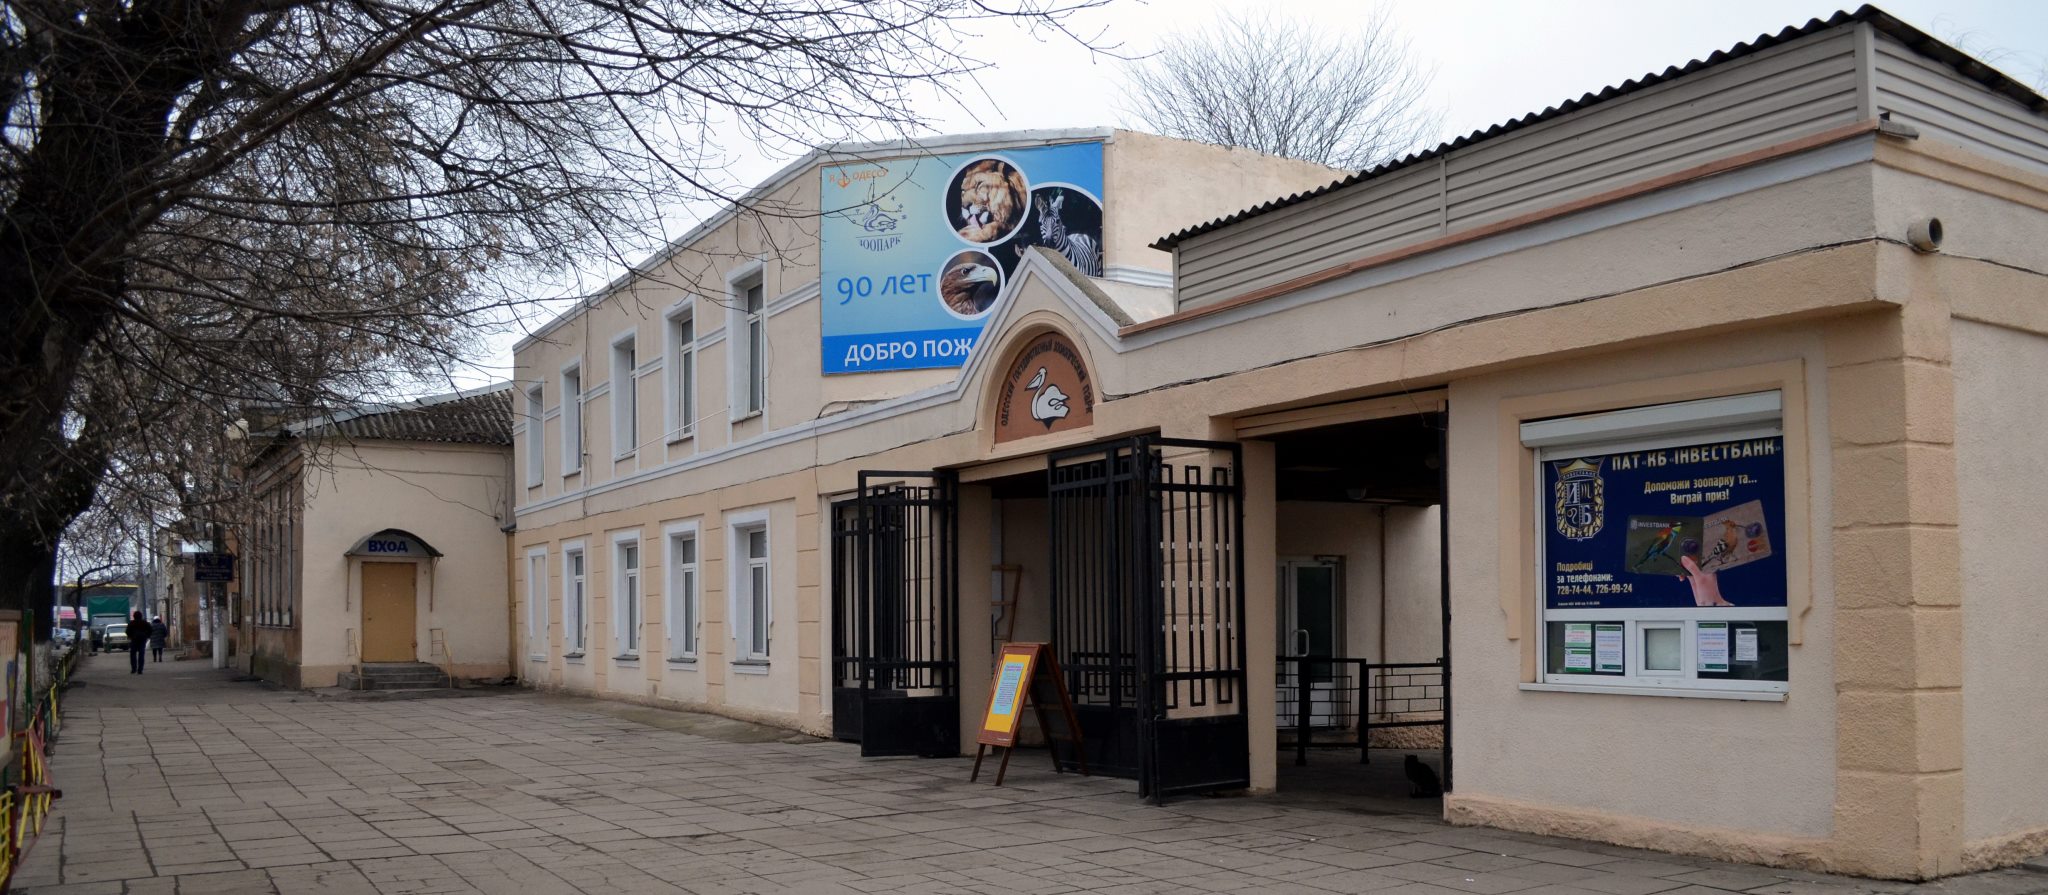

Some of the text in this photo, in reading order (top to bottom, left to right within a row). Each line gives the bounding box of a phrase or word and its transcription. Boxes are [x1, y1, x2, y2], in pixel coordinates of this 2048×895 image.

[837, 273, 932, 305] 90 лет
[844, 340, 917, 367] ДОБРО
[1612, 454, 1641, 471] ПАТ
[1644, 474, 1757, 495] Допоможи зоопарку та...
[1670, 489, 1730, 506] Виграй приз!
[368, 540, 408, 552] ВХОД
[1556, 560, 1593, 572] Подробиці
[1557, 573, 1614, 584] за телефонами:
[1557, 583, 1633, 595] 728-74-44, 726-99-24
